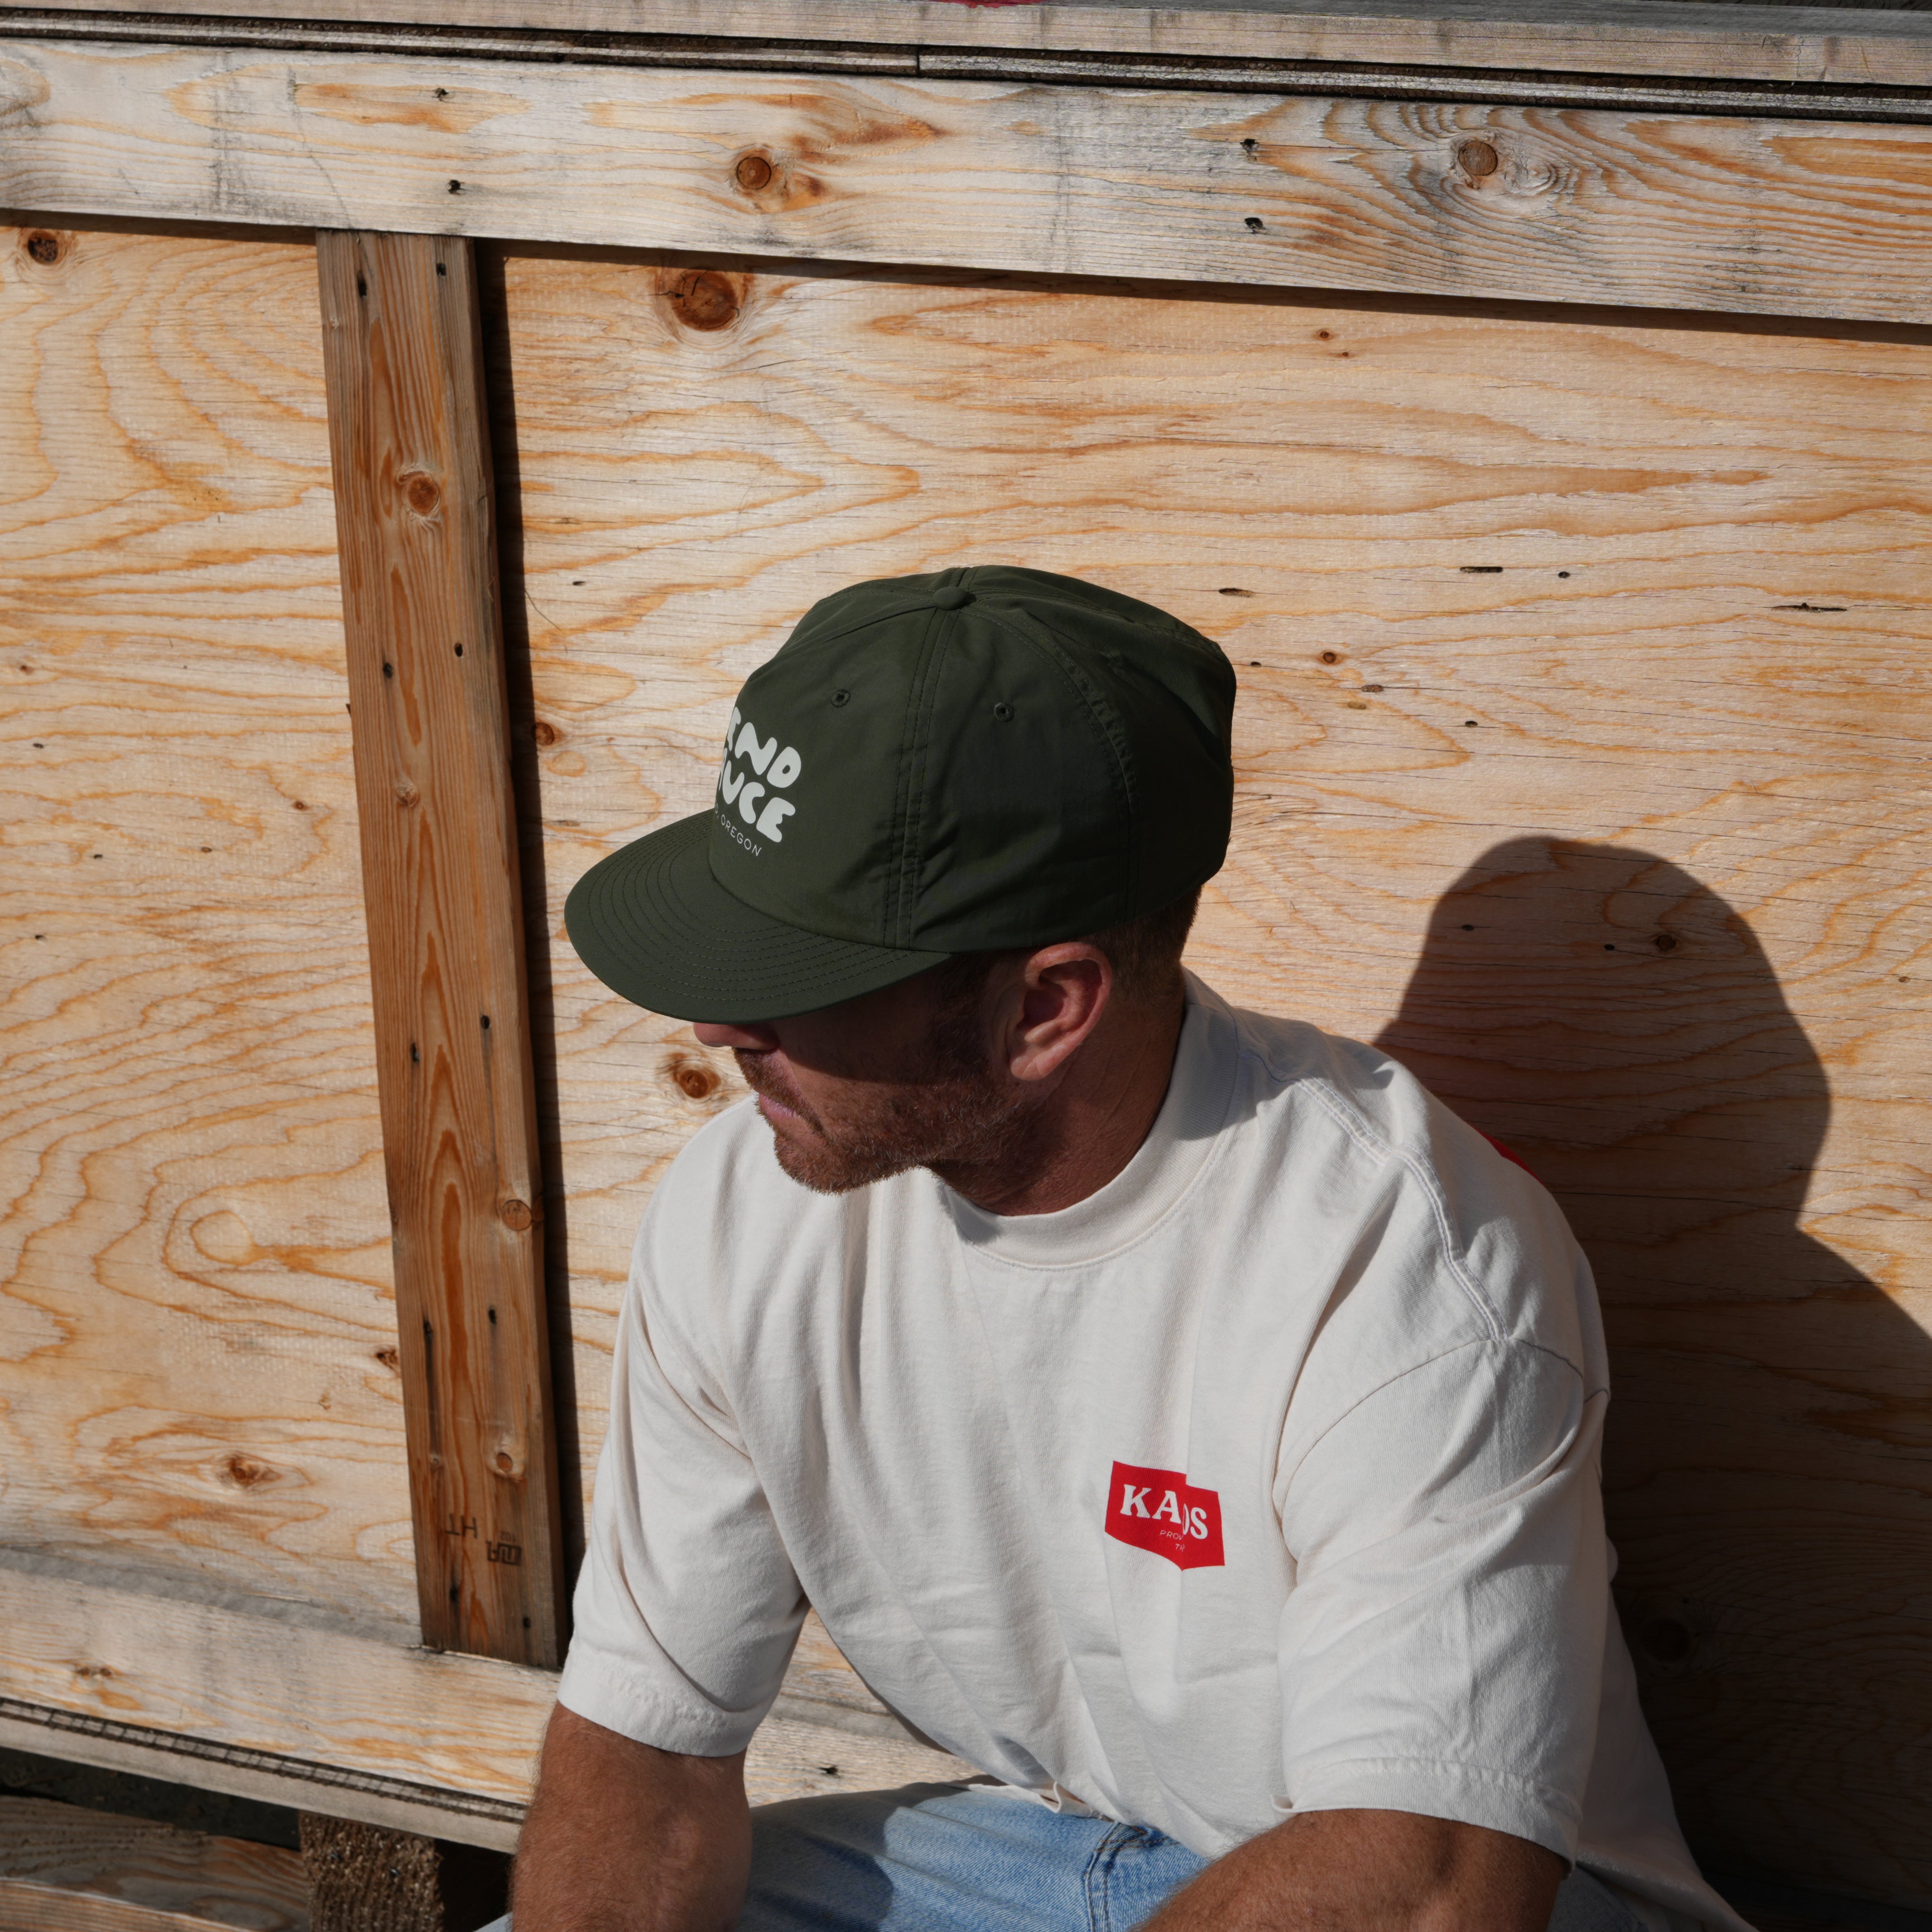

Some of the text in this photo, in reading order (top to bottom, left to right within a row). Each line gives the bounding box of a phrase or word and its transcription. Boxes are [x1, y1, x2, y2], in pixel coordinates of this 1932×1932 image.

[727, 706, 801, 788] END
[718, 747, 796, 843] AUCE
[721, 814, 762, 857] OREGON
[445, 1513, 477, 1539] HT
[1159, 1530, 1184, 1540] PROV
